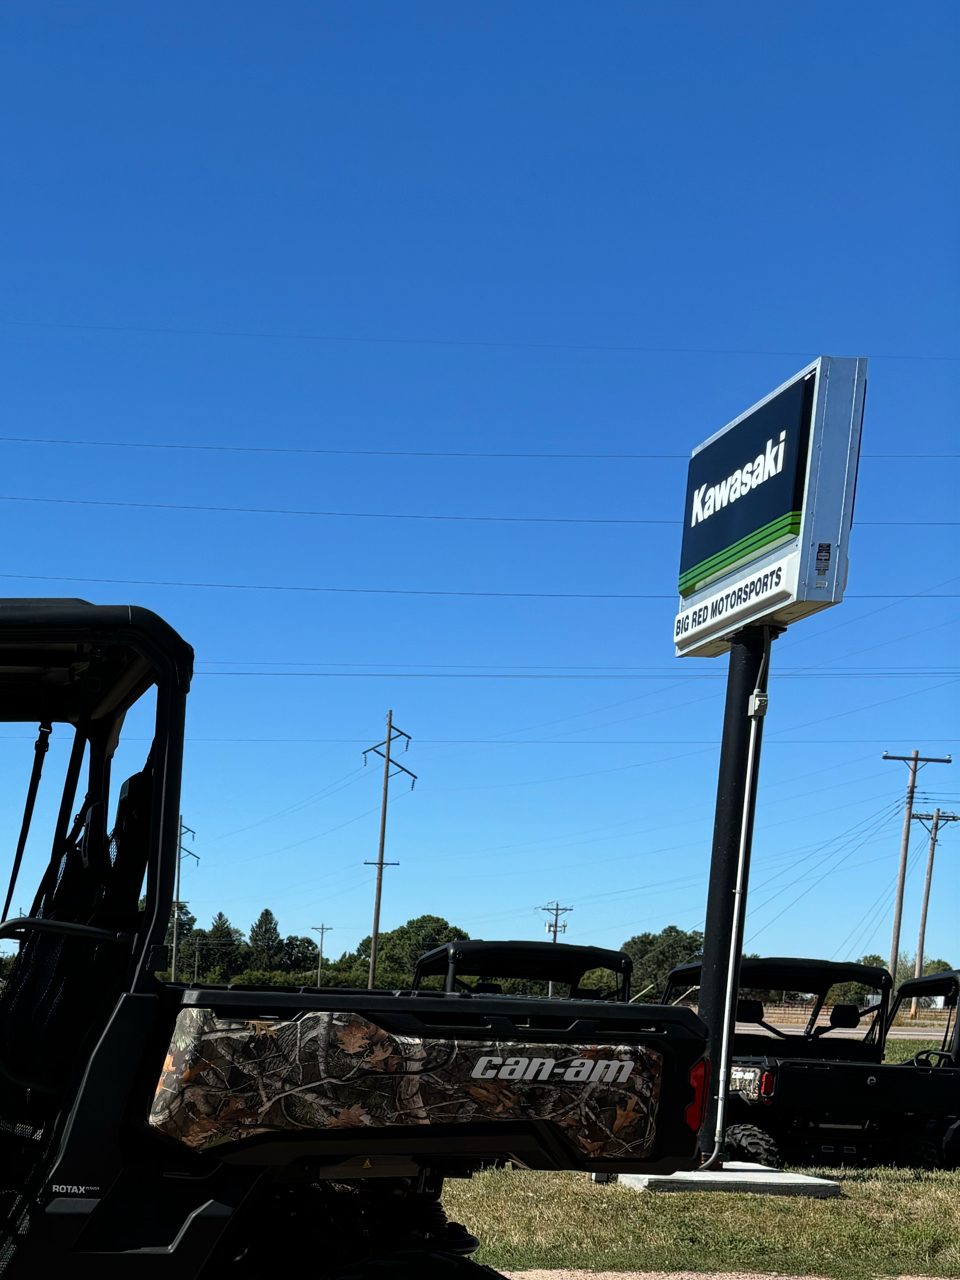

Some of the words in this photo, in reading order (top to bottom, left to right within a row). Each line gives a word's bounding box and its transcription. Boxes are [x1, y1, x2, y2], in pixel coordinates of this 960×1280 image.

[691, 429, 787, 528] Kawasaki
[675, 614, 690, 637] BIG
[691, 605, 709, 629] RED
[710, 566, 782, 620] MOTORSPORTS
[52, 1184, 86, 1194] ROTAX
